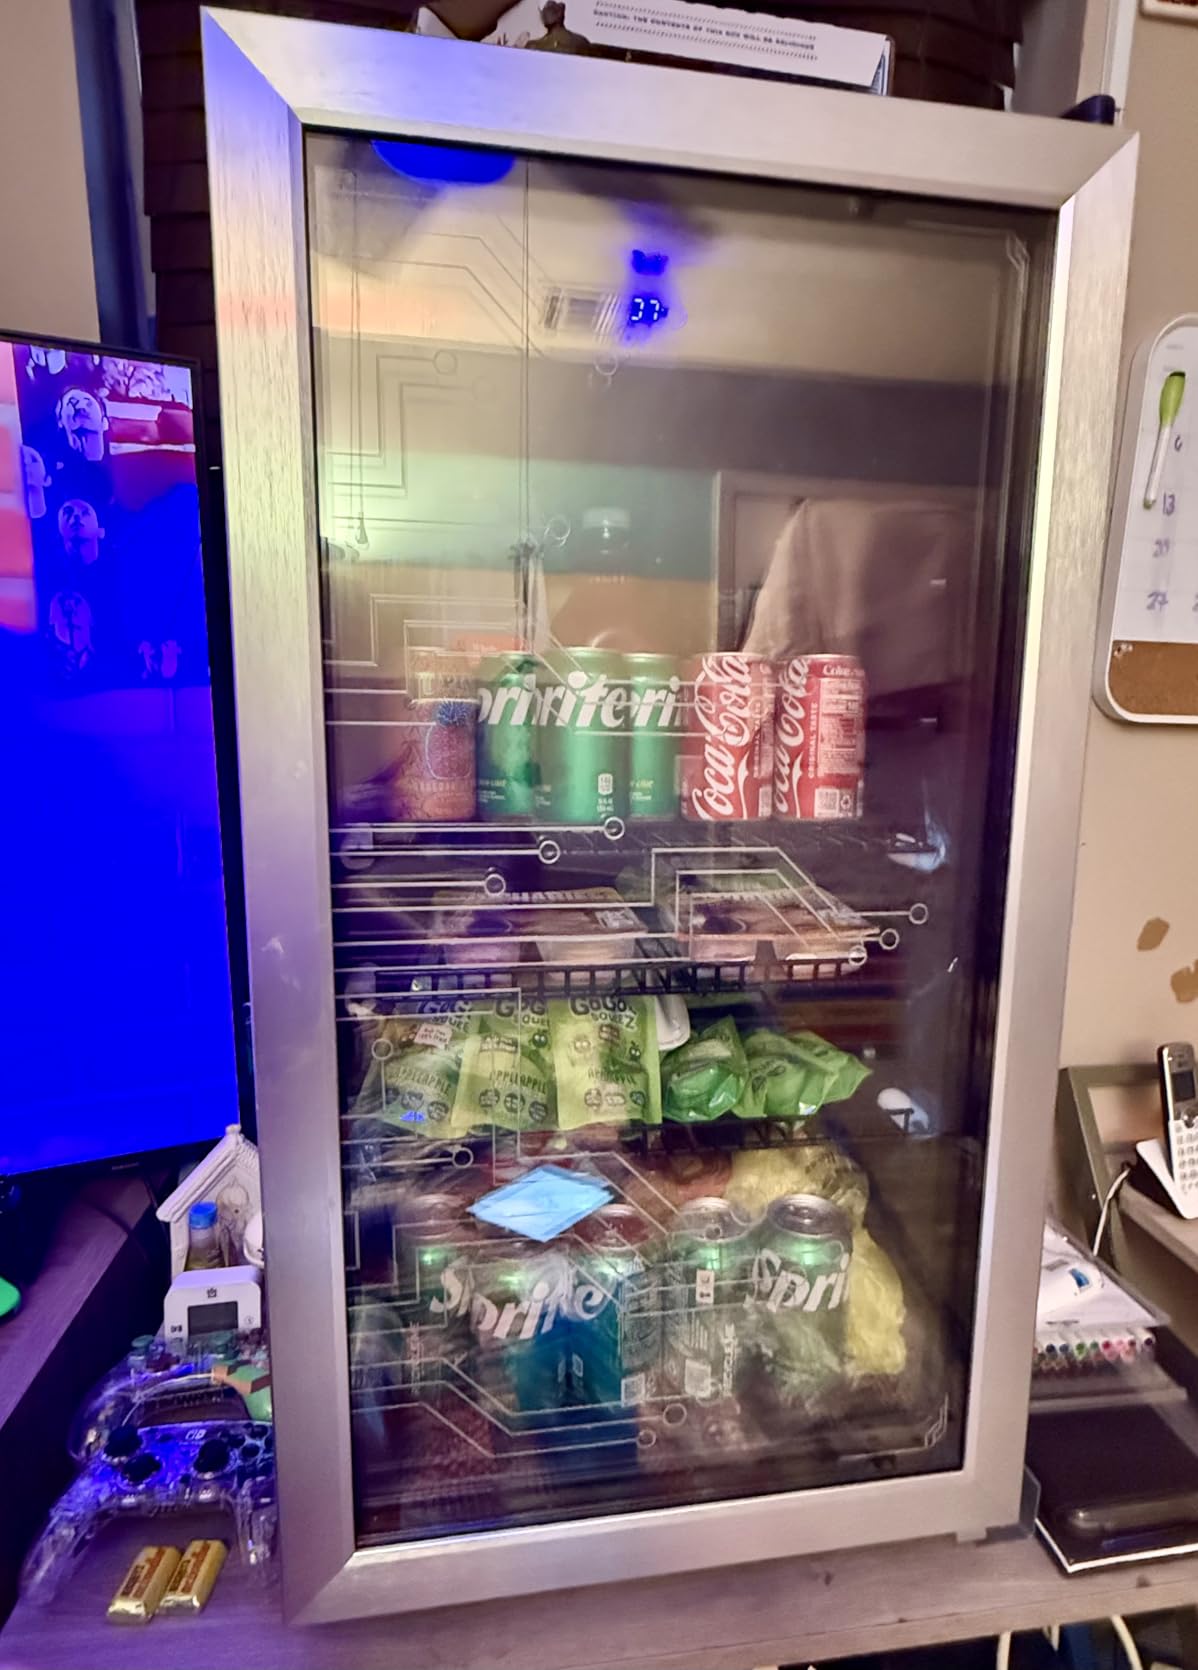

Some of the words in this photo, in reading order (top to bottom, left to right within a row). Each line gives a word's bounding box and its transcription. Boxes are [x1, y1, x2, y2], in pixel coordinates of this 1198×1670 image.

[633, 15, 648, 23] THE
[650, 18, 690, 30] CONTENTS
[705, 27, 723, 35] THIS
[743, 33, 761, 41] WILL
[1162, 491, 1176, 517] 13
[1146, 590, 1169, 611] 27
[809, 701, 819, 733] TASTE
